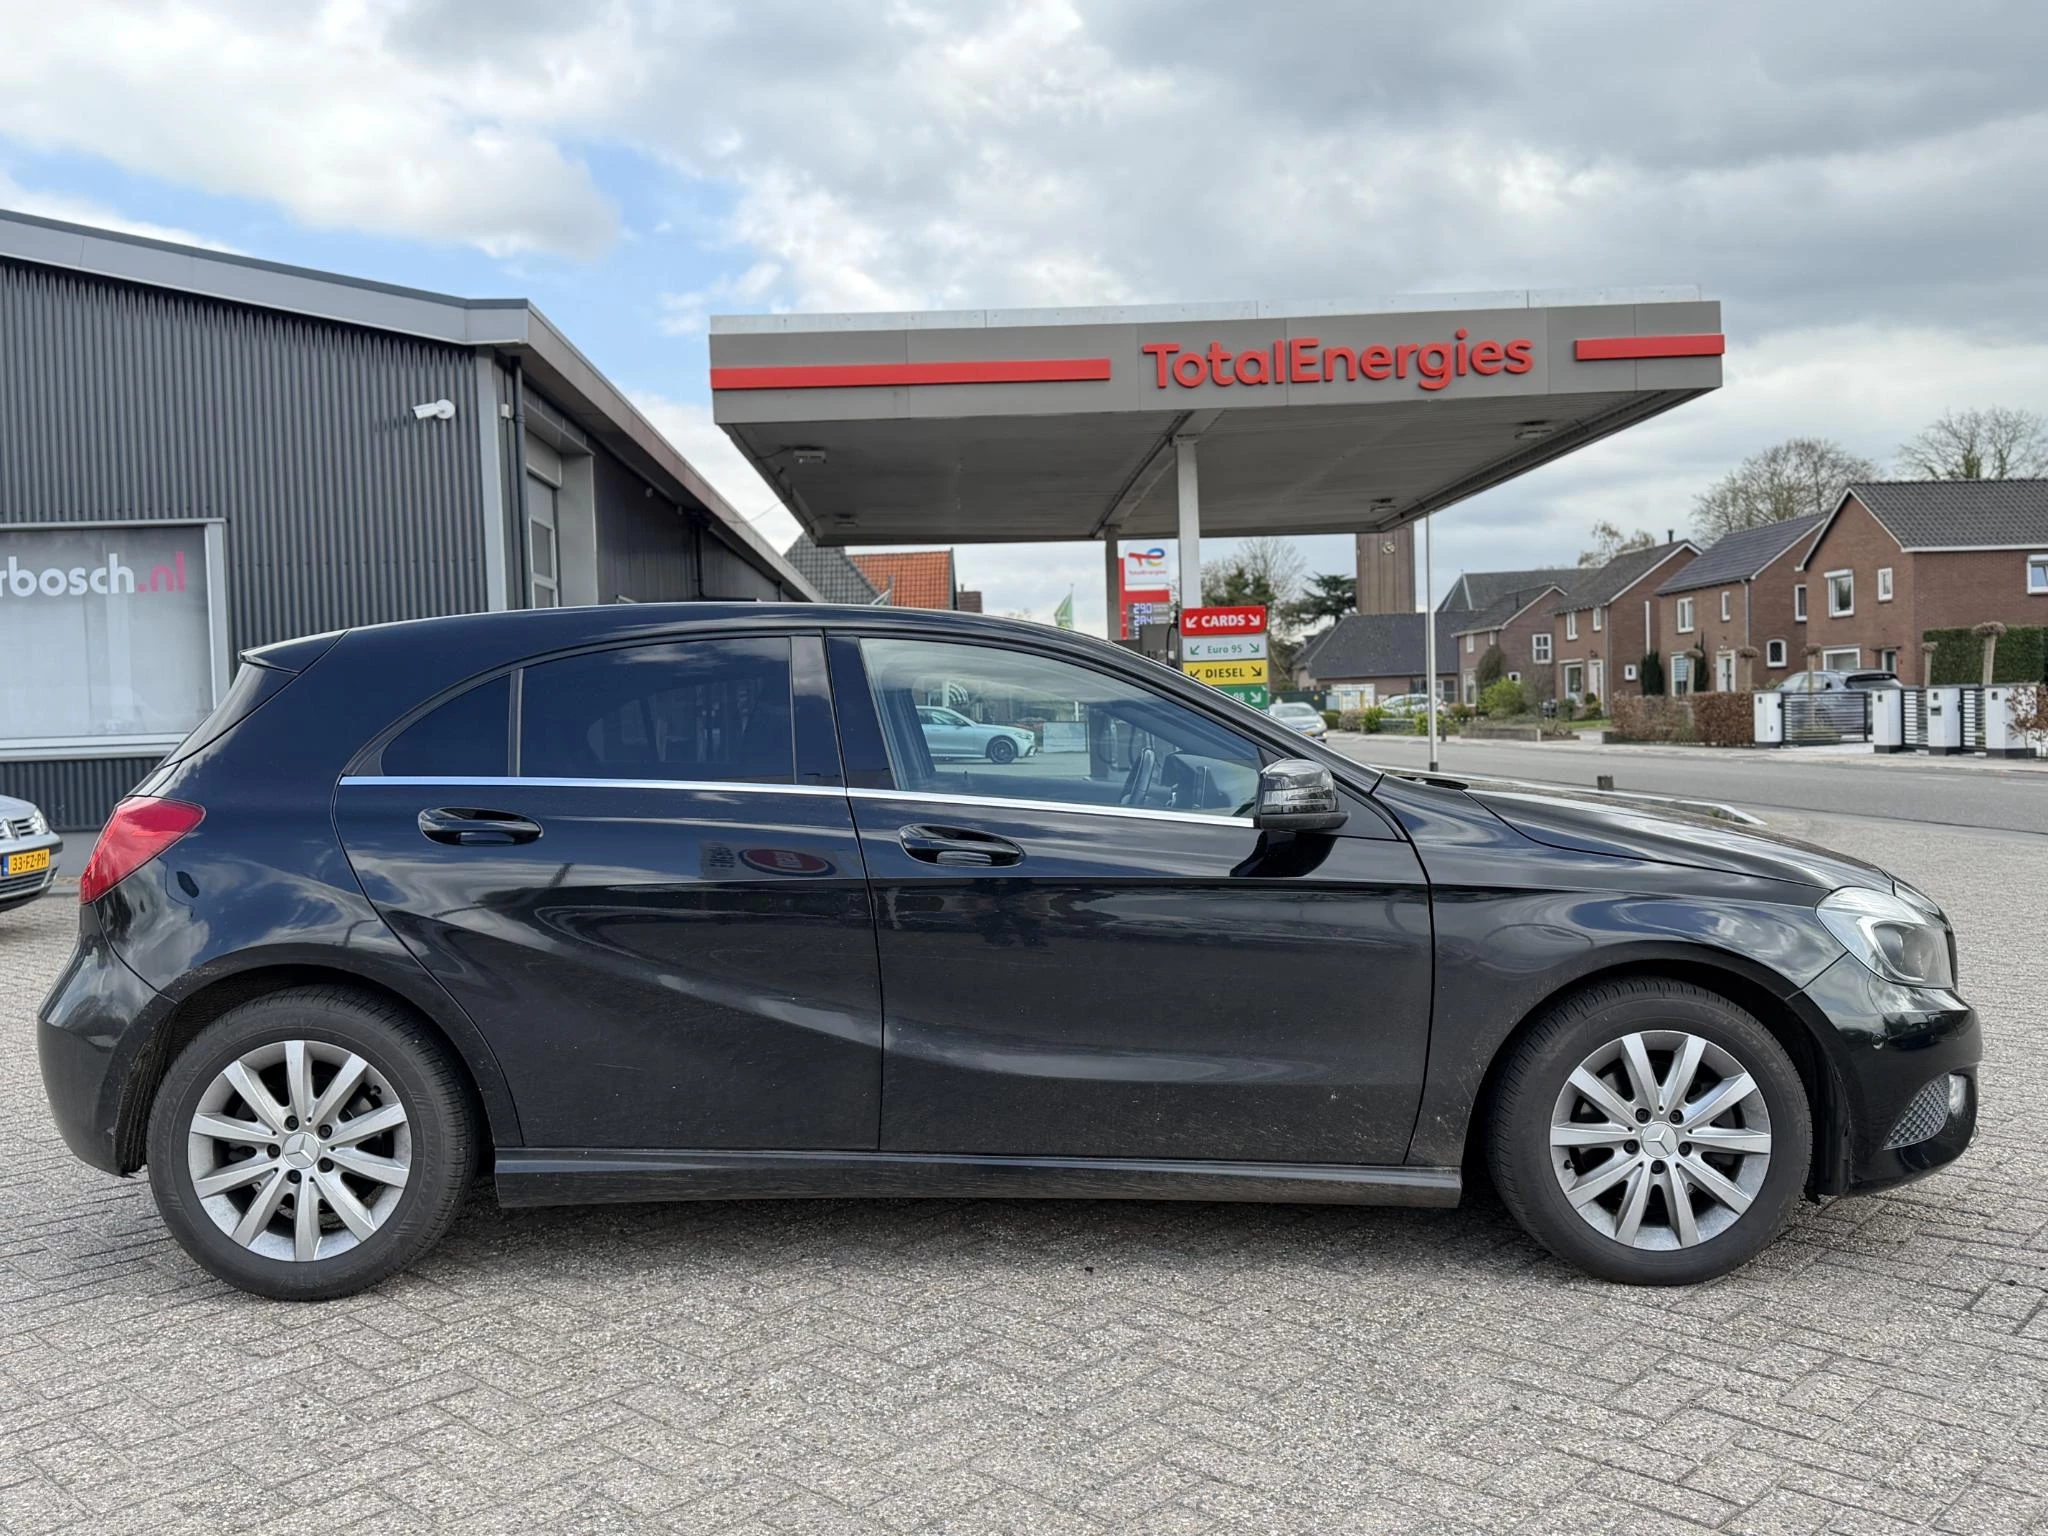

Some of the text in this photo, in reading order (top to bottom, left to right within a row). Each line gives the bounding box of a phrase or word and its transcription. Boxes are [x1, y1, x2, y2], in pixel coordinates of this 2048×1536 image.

[1143, 328, 1534, 391] TotalEnergies
[1201, 614, 1246, 628] CARDS
[1207, 644, 1243, 653] Euro 95
[1205, 667, 1246, 679] DIESEL
